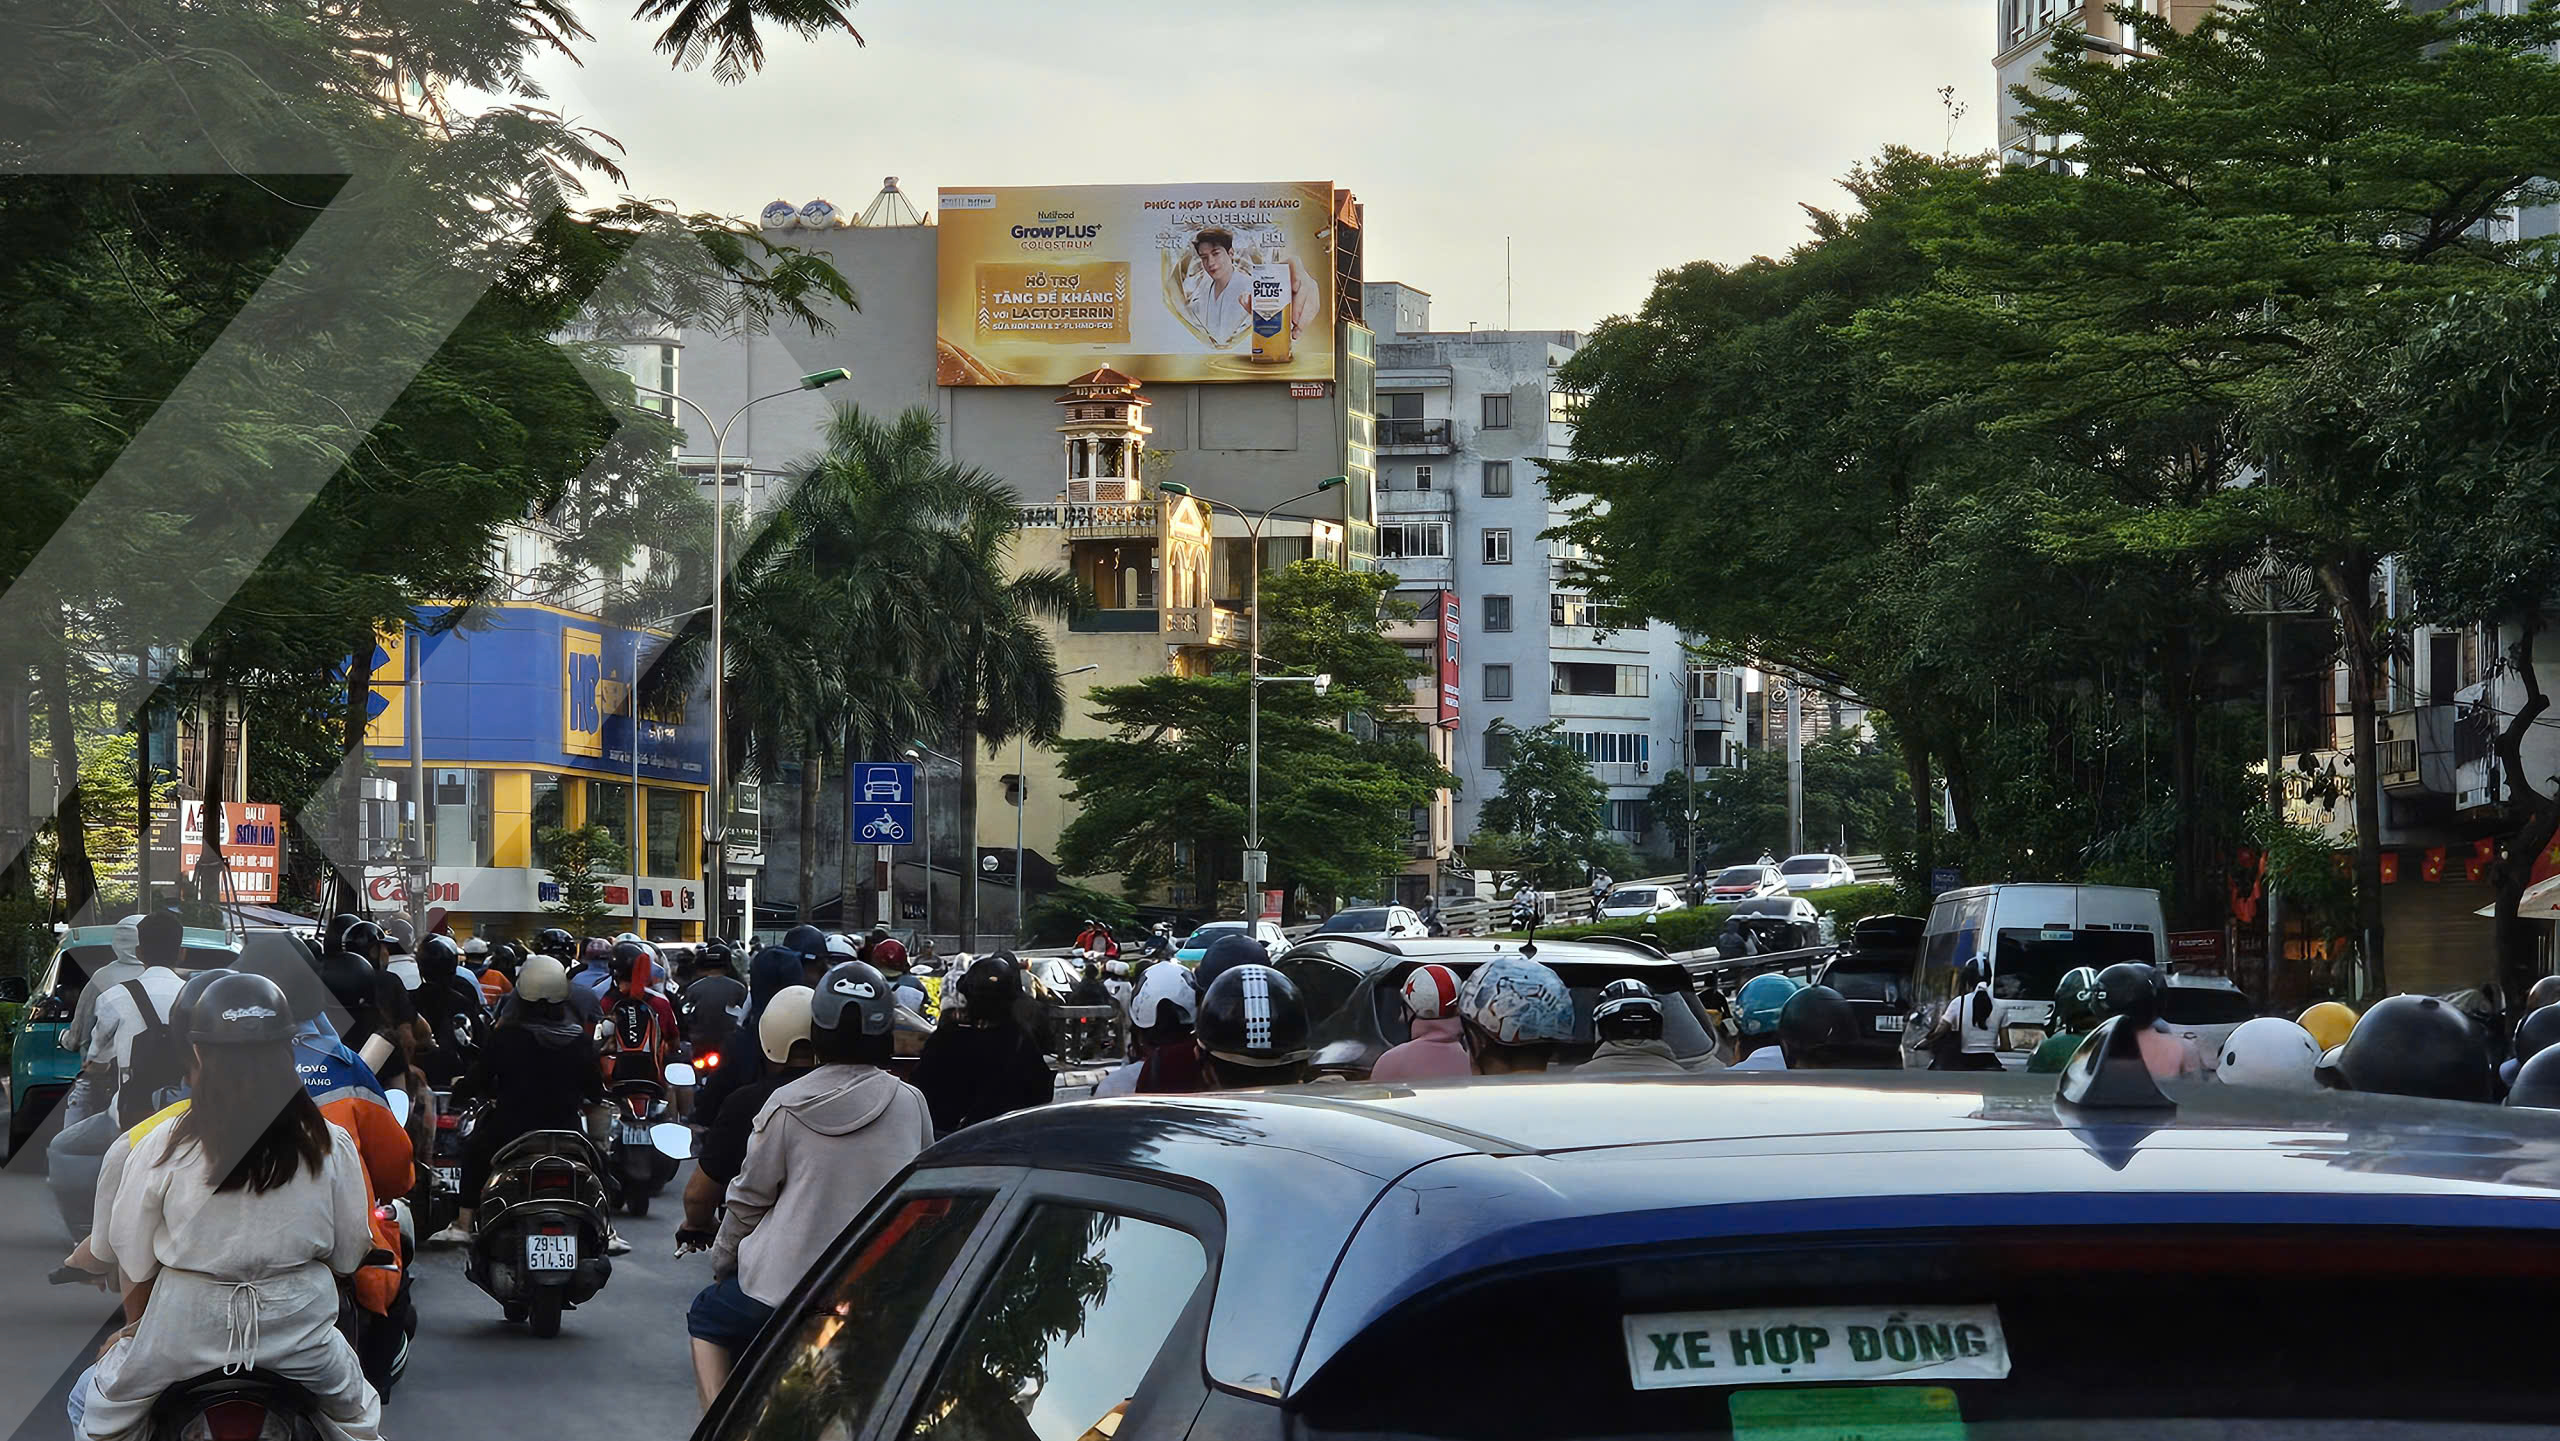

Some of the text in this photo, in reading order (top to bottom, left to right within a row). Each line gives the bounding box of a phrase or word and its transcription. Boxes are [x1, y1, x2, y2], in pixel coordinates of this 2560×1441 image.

[1144, 199, 1175, 210] PHỨC
[1178, 200, 1203, 211] HỢP
[1206, 198, 1237, 209] TĂNG
[1258, 198, 1300, 209] KHÁNG
[1172, 212, 1273, 225] LACTOFERRIN
[1021, 241, 1093, 250] COLOSTRUM
[1025, 272, 1080, 290] HỖ TRỢ
[993, 290, 1033, 304] TĂNG
[1062, 290, 1113, 303] KHÁNG
[1012, 307, 1114, 320] LACTOFERRIN
[534, 1236, 569, 1252] 29-L1
[530, 1253, 574, 1269] 514.58
[1647, 1311, 1990, 1374] XE HỢP ĐỒNG
